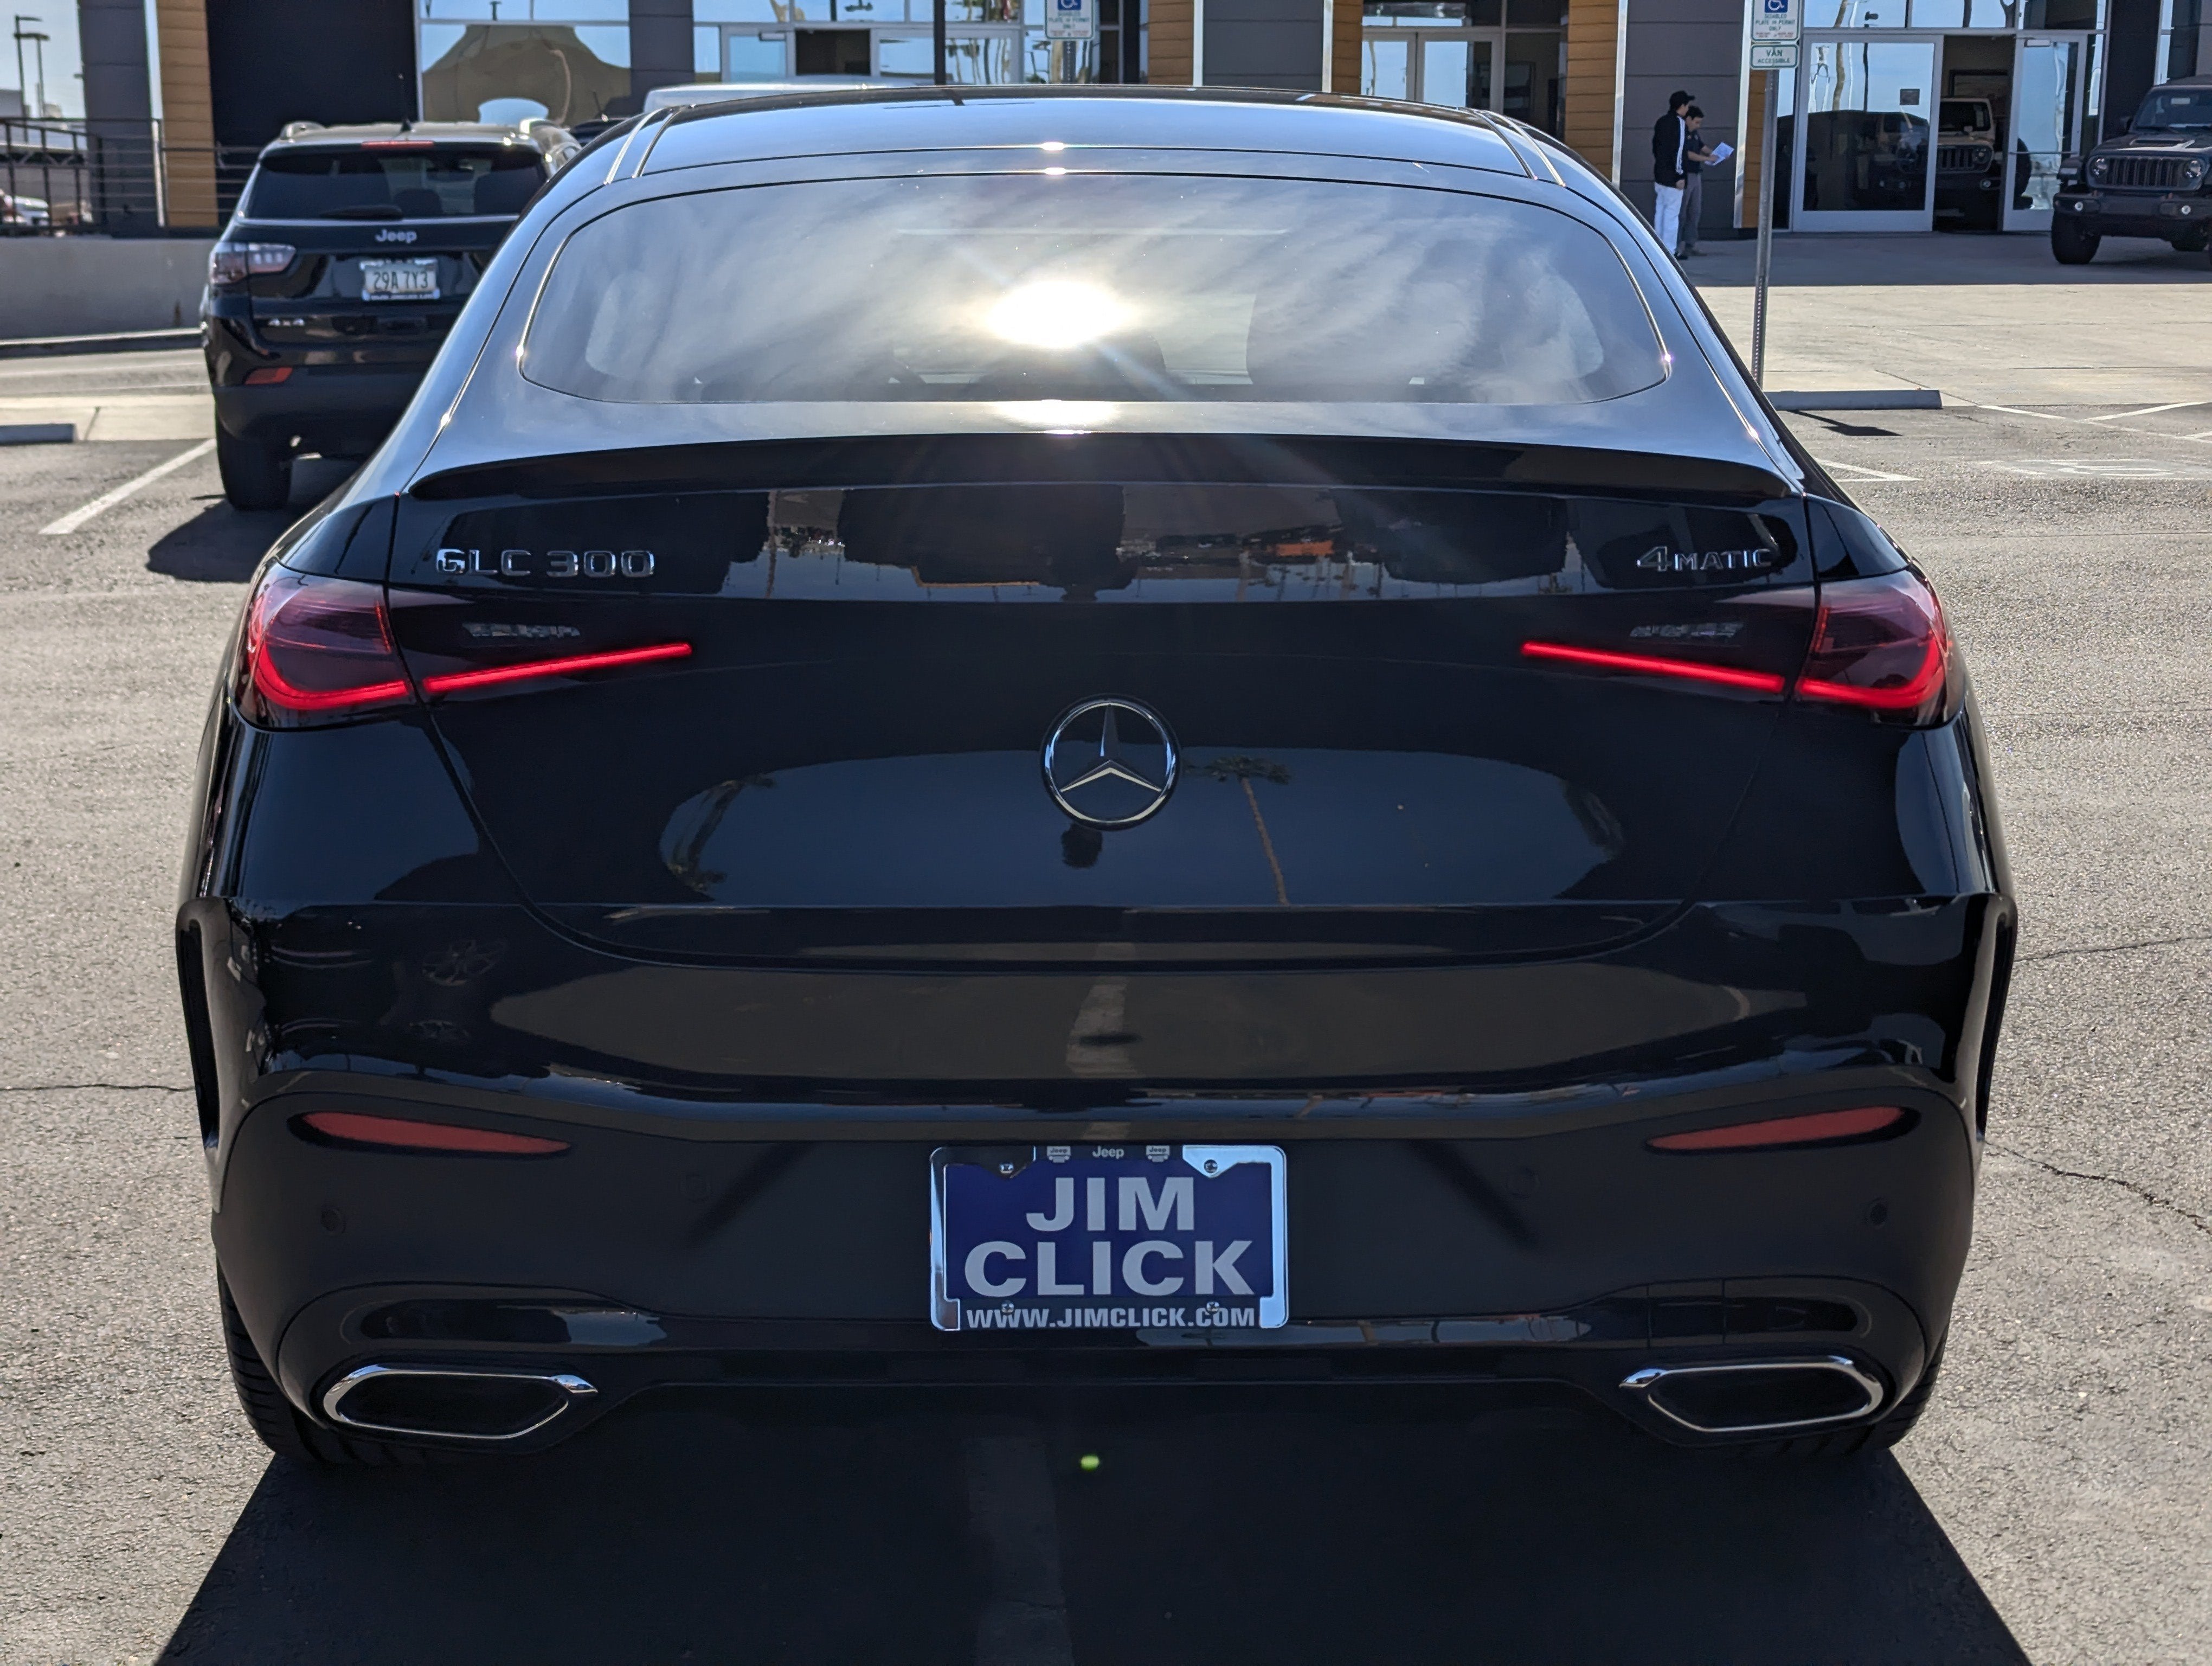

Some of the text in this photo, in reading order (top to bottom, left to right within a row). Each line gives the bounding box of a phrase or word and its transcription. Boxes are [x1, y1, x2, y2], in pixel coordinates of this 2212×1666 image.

[375, 229, 417, 244] Jeep
[374, 271, 428, 290] 29A 7Y3
[436, 548, 655, 578] GLC 300
[1636, 546, 1772, 572] 4MATIC
[1092, 1146, 1124, 1159] Jeep
[1026, 1177, 1194, 1232] JIM
[964, 1240, 1255, 1297] CLICK
[966, 1308, 1255, 1329] WWW.JIMCLICK.COM
